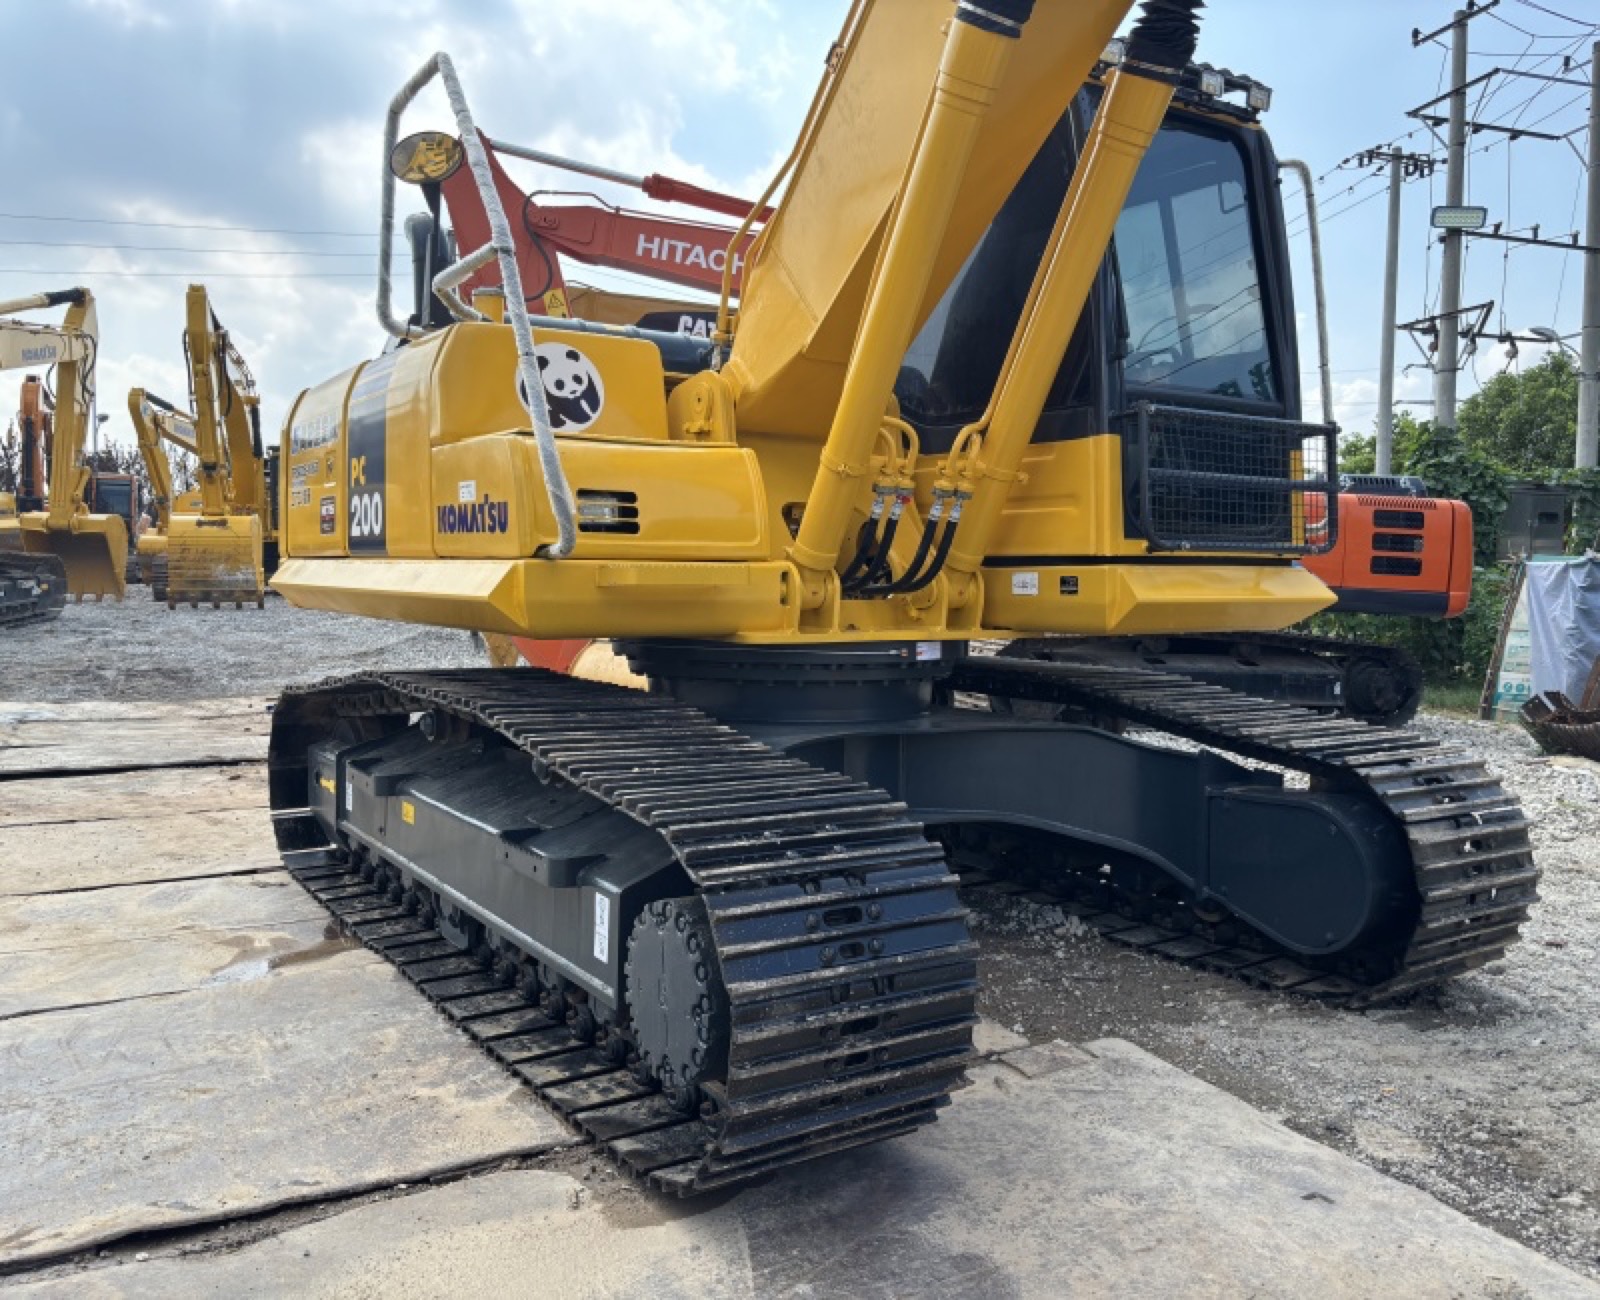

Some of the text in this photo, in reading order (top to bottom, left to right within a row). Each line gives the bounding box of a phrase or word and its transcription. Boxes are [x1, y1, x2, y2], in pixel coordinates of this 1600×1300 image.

[351, 455, 367, 488] PC
[350, 492, 383, 537] 200
[437, 493, 509, 534] KOMATSU
